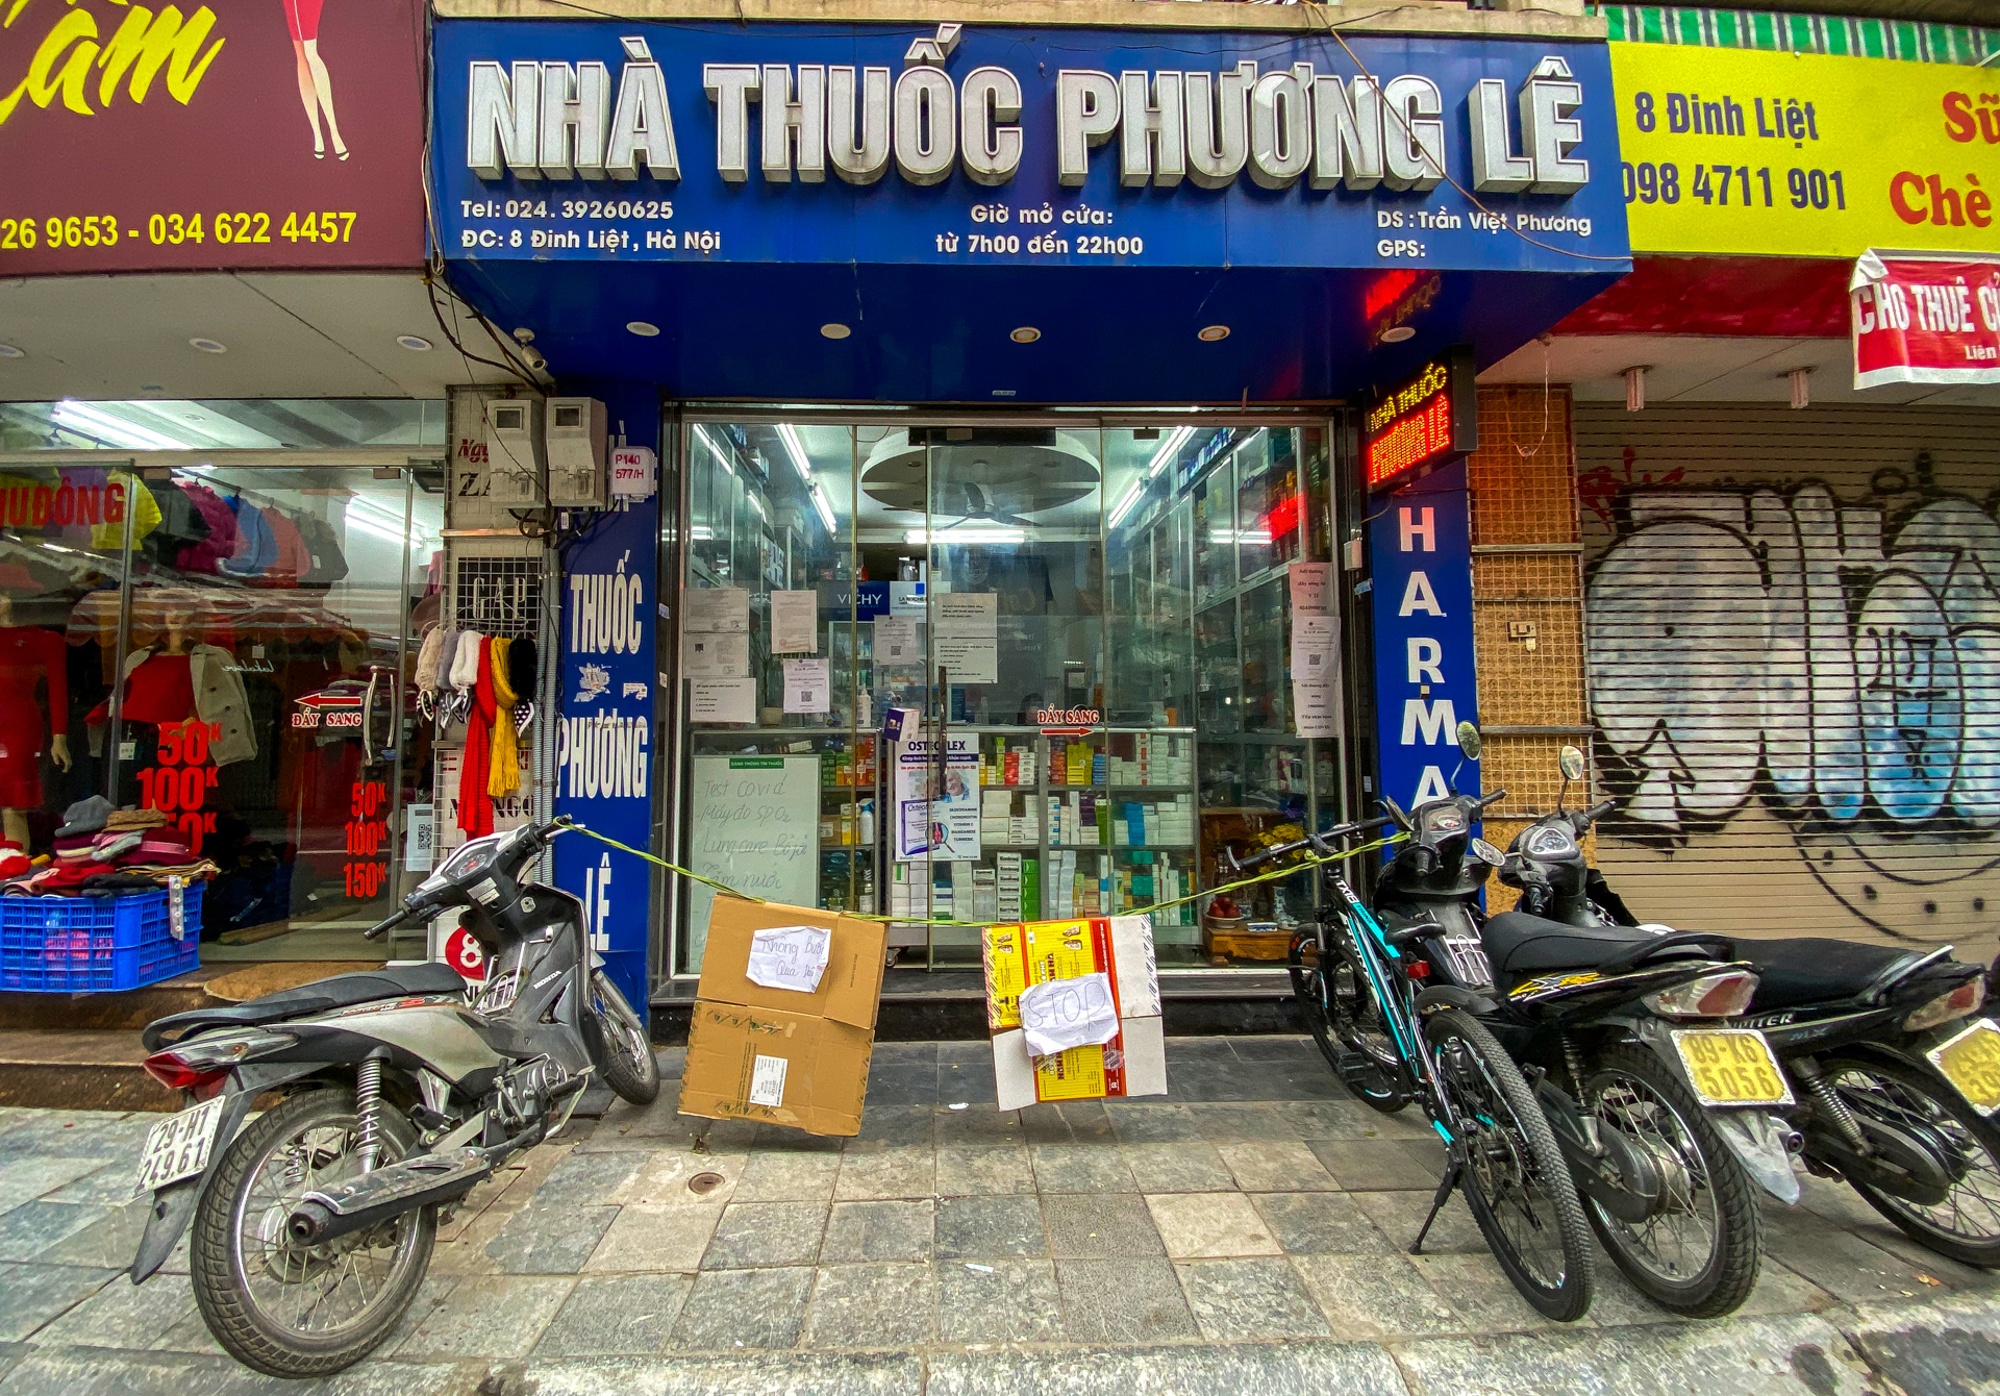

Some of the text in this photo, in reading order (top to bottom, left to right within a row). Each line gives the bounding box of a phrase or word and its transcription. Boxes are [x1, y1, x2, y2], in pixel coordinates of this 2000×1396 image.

[466, 22, 1590, 195] NHÀ THUỐC PHƯƠNG LÊ
[1634, 91, 1820, 149] 8 Đinh Liệt
[1692, 163, 1773, 208] 4711
[1787, 168, 1846, 211] 901
[1889, 170, 1992, 228] Chè
[460, 200, 501, 219] Tel:
[970, 202, 1114, 225] Giờ mở cửa:
[1468, 211, 1508, 235] Việt
[1516, 213, 1592, 237] Phương
[46, 214, 119, 247] 9653
[148, 213, 205, 245] 034
[214, 212, 271, 244] 622
[280, 211, 357, 244] 4457
[461, 229, 504, 249] ĐC:
[509, 229, 523, 248] 8
[530, 229, 580, 249] Đinh
[646, 228, 677, 249] Hà
[684, 229, 721, 254] Nội
[936, 230, 1144, 256] từ 7h00 đến 22h00
[1376, 239, 1426, 258] GPS:
[1851, 282, 1910, 334] CHO
[1910, 275, 1976, 333] THUÊ
[1965, 345, 1997, 360] Liên
[1370, 360, 1448, 433] NHÀ THUỐC
[1427, 393, 1450, 453] LÊ
[615, 453, 641, 465] P140
[570, 549, 643, 655] THUỐC
[291, 706, 363, 727] ĐẨY SANG
[1037, 703, 1100, 724] ĐẨY SANG
[156, 720, 223, 766] 50K
[555, 707, 649, 799] PHƯƠNG
[136, 766, 219, 812] 100K
[351, 781, 387, 817] 50K
[703, 773, 788, 799] Test Covid
[344, 820, 387, 857] 100K
[343, 861, 387, 898] 150K
[587, 851, 612, 951] LÊ
[459, 932, 483, 969] 8
[532, 970, 563, 990] HONDA
[1027, 981, 1106, 1032] STOP
[1699, 1066, 1776, 1098] 5056
[152, 1105, 211, 1154] 29-H1
